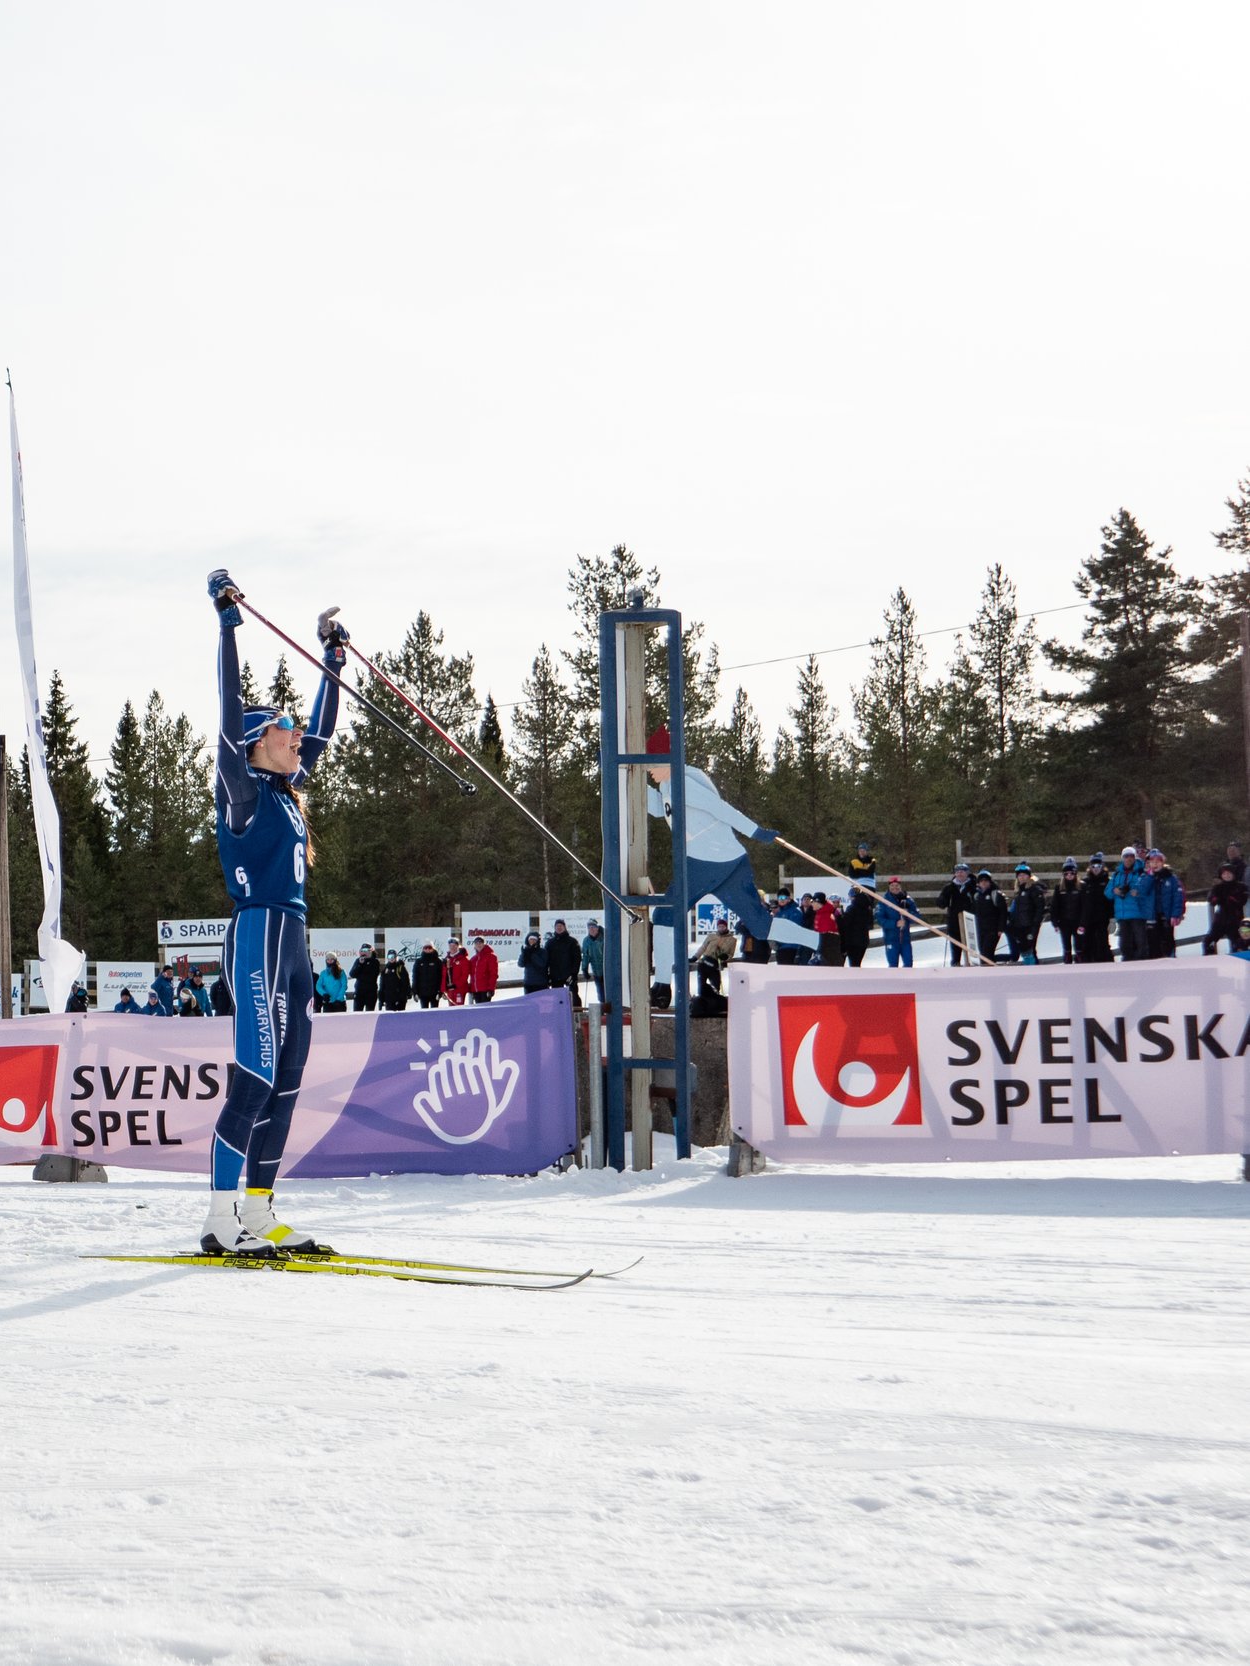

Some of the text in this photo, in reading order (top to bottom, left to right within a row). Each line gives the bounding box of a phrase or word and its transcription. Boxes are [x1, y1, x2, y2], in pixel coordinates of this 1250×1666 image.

[234, 866, 248, 885] 6
[292, 842, 305, 884] 6
[312, 946, 358, 958] Swbank
[249, 969, 272, 1068] VITTJÄRVSHUS
[949, 1078, 1122, 1126] SPEL
[71, 1110, 183, 1147] SPEL
[222, 1258, 286, 1270] FISCHER
